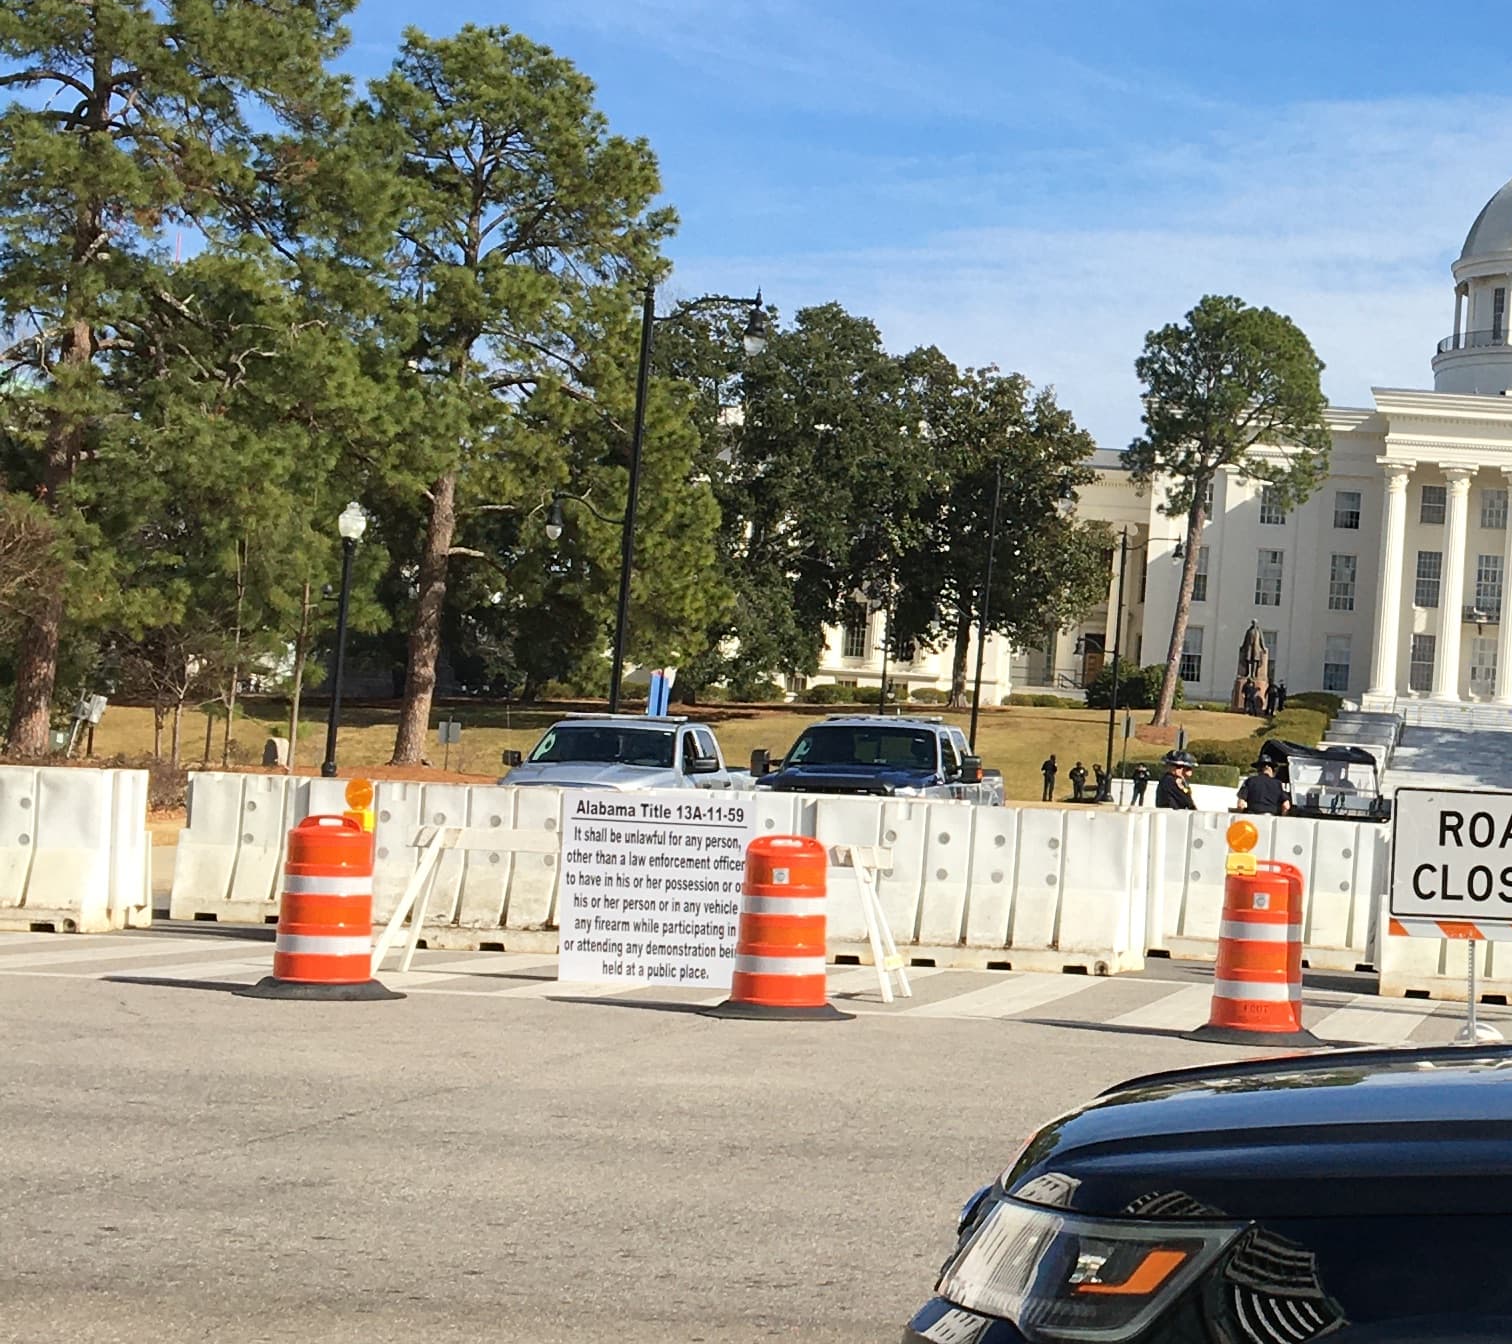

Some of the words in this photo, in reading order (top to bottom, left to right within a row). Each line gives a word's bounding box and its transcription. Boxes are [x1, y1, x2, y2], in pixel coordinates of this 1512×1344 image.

[576, 800, 636, 816] Alabama
[641, 803, 671, 819] Title
[676, 805, 744, 822] 13A-11-59
[574, 826, 581, 841] It
[584, 827, 607, 842] shall
[610, 828, 622, 843] be
[625, 829, 666, 845] unlawful
[669, 831, 682, 846] for
[685, 835, 702, 851] any
[706, 837, 741, 852] person,
[566, 848, 592, 863] other
[596, 850, 617, 865] than
[620, 854, 626, 865] a
[629, 851, 646, 866] law
[649, 853, 711, 870] enforcement
[713, 856, 745, 871] officer
[566, 872, 576, 885] to
[579, 871, 601, 886] have
[605, 872, 613, 887] in
[616, 873, 630, 888] his
[633, 877, 644, 888] or
[646, 874, 662, 889] her
[665, 876, 719, 893] possession
[722, 881, 733, 893] or
[735, 882, 743, 893] o
[573, 893, 588, 908] his
[591, 897, 601, 908] or
[604, 894, 620, 909] her
[623, 898, 656, 912] person
[659, 900, 669, 911] or
[672, 897, 680, 912] in
[683, 901, 701, 917] any
[704, 899, 738, 914] vehicle
[574, 918, 592, 934] any
[594, 915, 630, 931] firearm
[633, 918, 659, 933] while
[662, 920, 724, 940] participating
[728, 922, 736, 936] in
[564, 939, 574, 951] or
[577, 938, 623, 957] attending
[626, 942, 643, 958] any
[646, 940, 716, 957] demonstration
[719, 943, 737, 959] bei
[602, 960, 623, 975] held
[626, 962, 636, 976] at
[638, 965, 644, 976] a
[647, 963, 677, 980] public
[680, 964, 709, 982] place.
